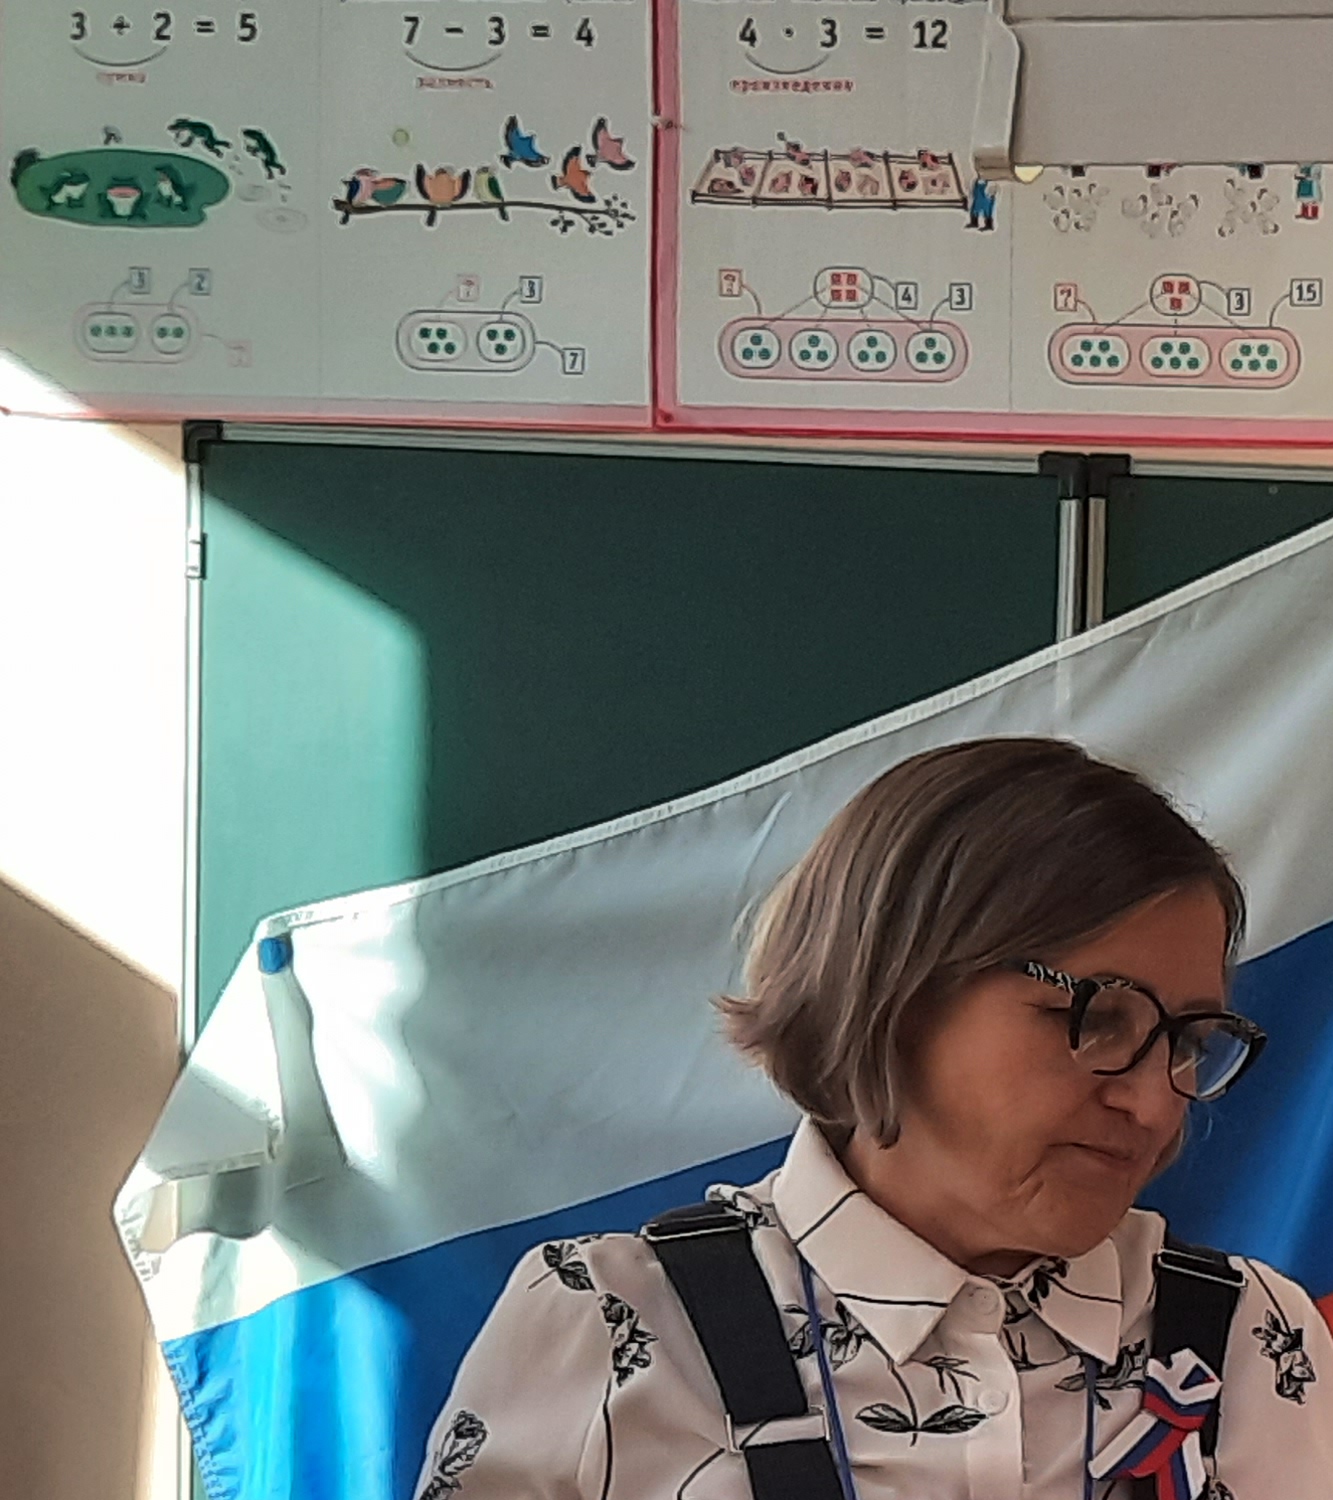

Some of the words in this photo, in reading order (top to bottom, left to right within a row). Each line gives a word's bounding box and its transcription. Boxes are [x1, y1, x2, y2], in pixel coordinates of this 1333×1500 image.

[69, 11, 87, 41] 3
[153, 12, 172, 41] 2
[237, 12, 258, 43] 5
[403, 16, 421, 45] 7
[487, 16, 506, 46] 3
[574, 17, 595, 47] 4
[739, 17, 757, 48] 4
[820, 18, 838, 49] 3
[912, 19, 948, 49] 12
[1296, 282, 1317, 302] 15
